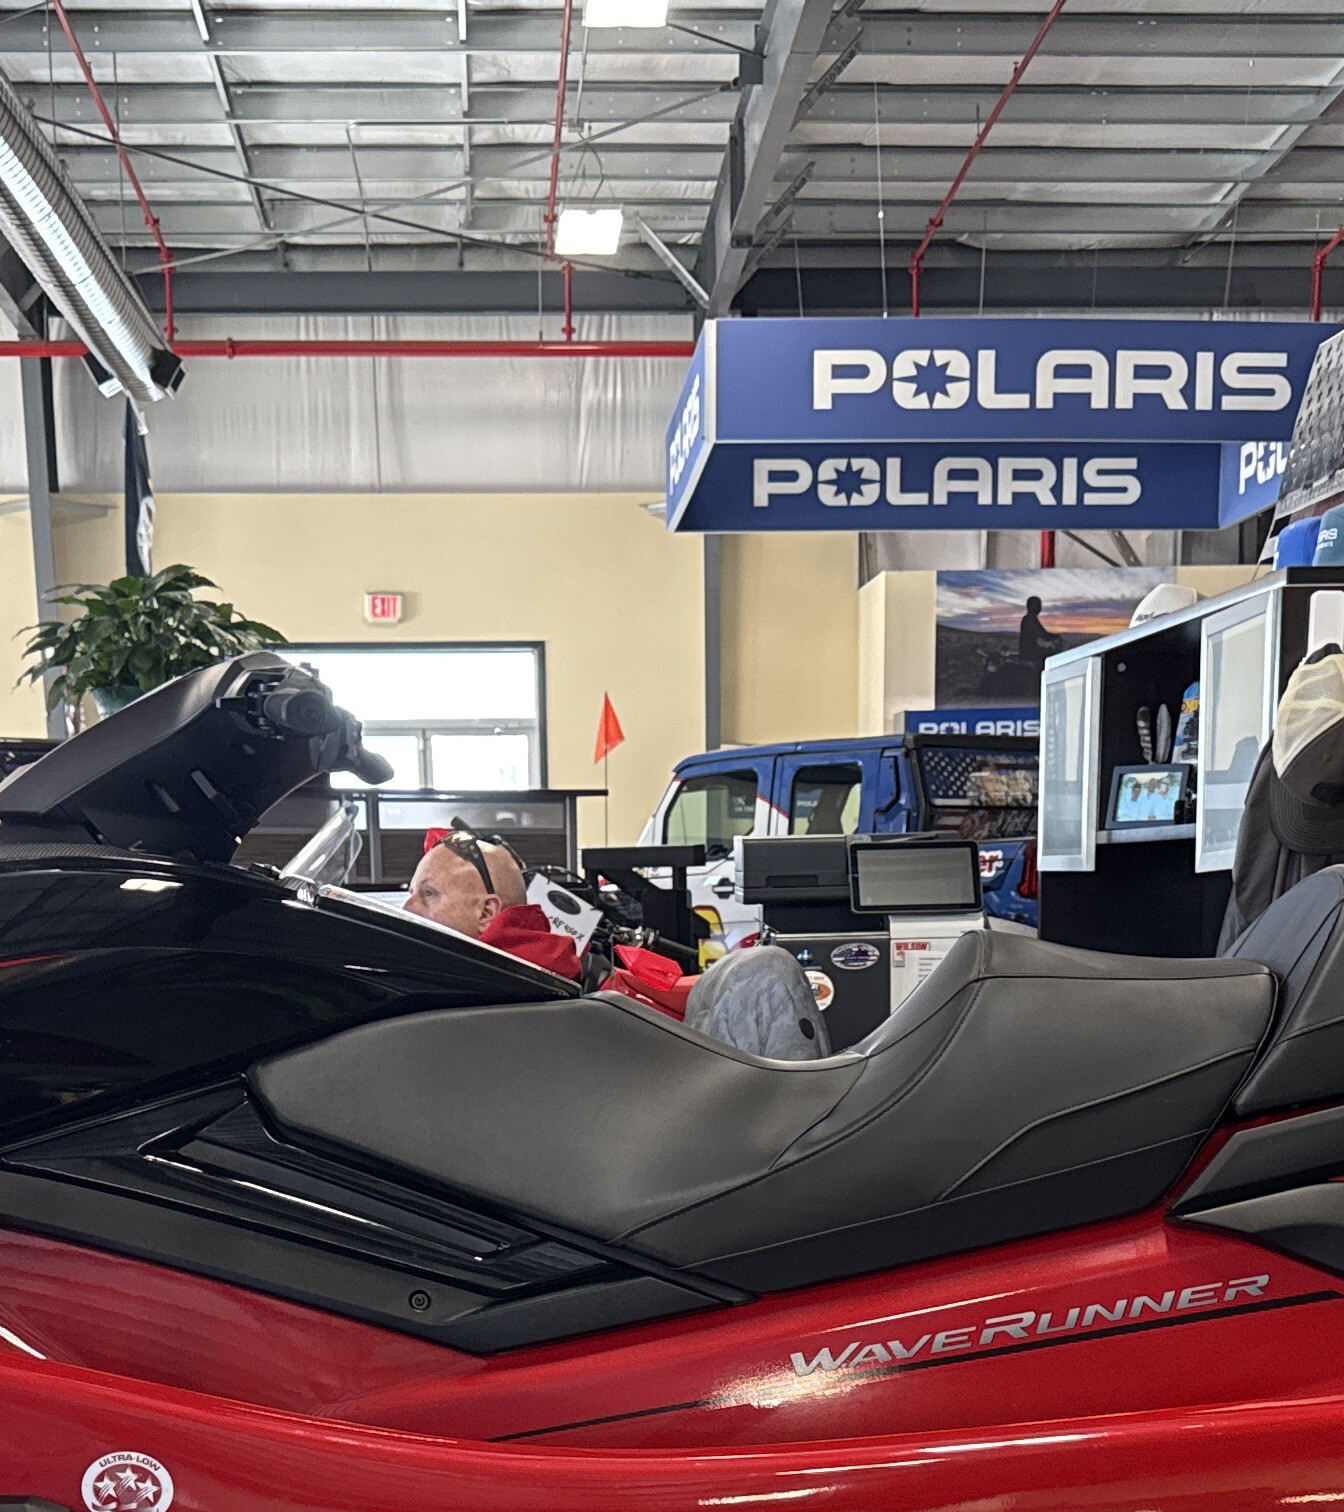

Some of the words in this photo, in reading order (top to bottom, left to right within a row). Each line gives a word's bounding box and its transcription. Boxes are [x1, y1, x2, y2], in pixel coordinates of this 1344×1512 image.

[813, 349, 1293, 412] POLARIS
[753, 457, 1142, 508] POLARIS
[371, 596, 398, 618] EXIT
[895, 942, 929, 951] WILSON
